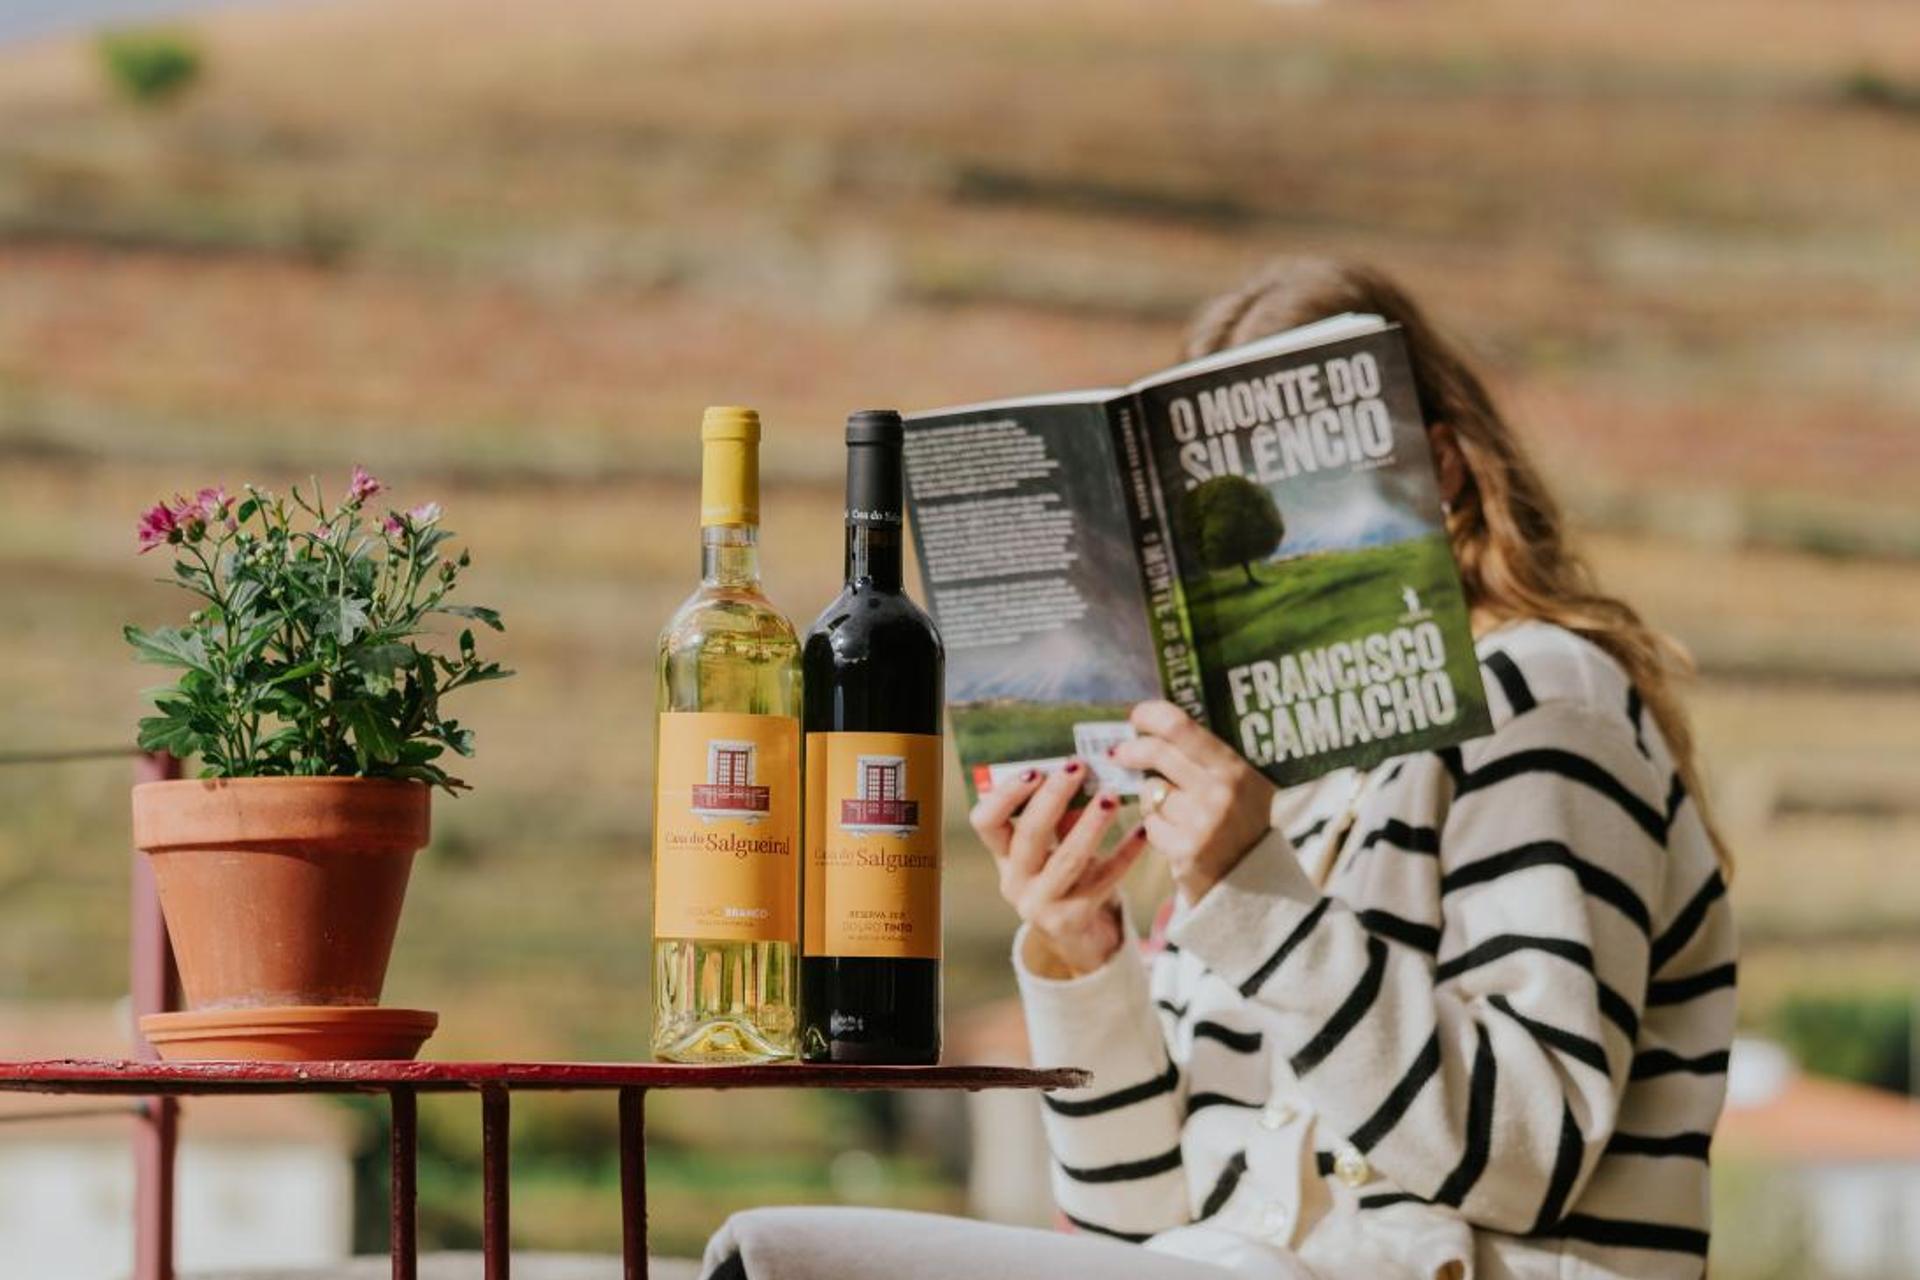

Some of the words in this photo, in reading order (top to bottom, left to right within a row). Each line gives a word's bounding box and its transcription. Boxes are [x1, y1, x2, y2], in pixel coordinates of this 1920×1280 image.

[1169, 397, 1198, 443] O
[1198, 364, 1327, 436] MONTE
[1325, 352, 1381, 406] DO
[1143, 545, 1172, 619] MONTE
[1228, 622, 1446, 716] FRANCISCO
[1240, 670, 1457, 767] CAMACHO
[705, 832, 790, 859] Salgueiral
[725, 908, 768, 919] BRANCO
[849, 910, 887, 920] RESERVA
[883, 922, 913, 934] TINTO
